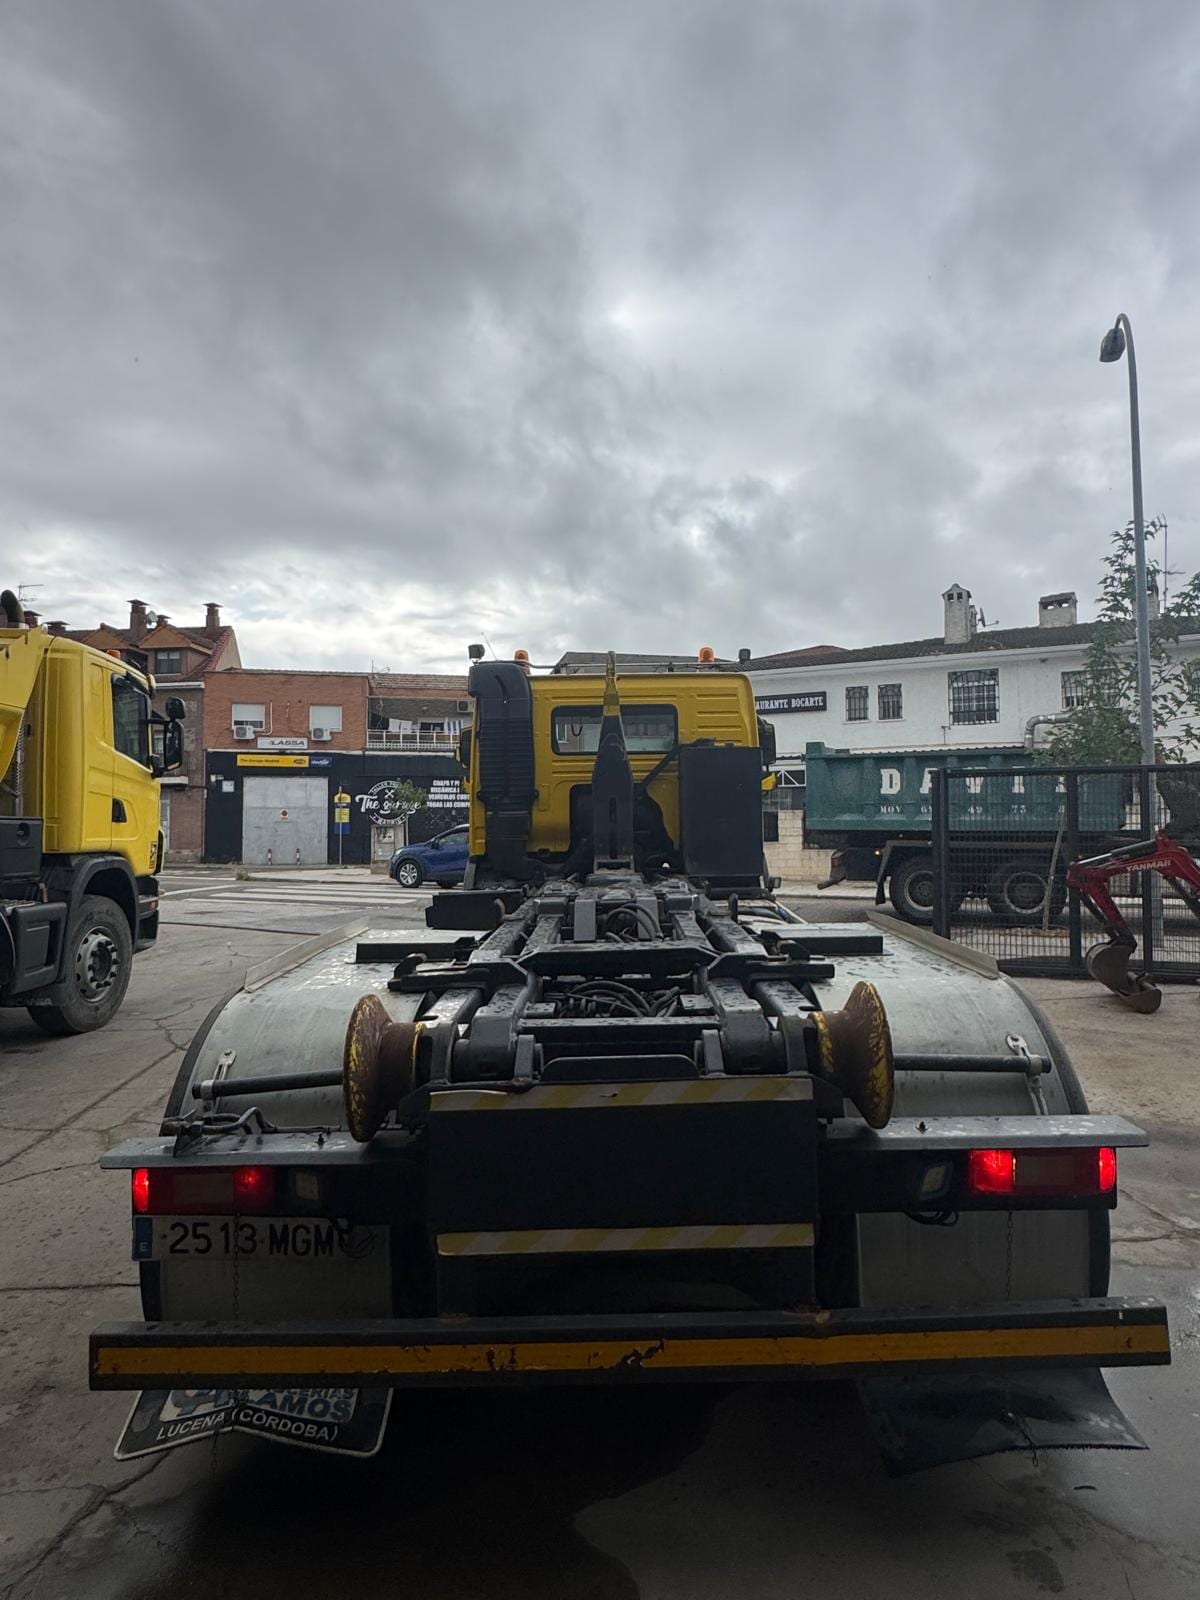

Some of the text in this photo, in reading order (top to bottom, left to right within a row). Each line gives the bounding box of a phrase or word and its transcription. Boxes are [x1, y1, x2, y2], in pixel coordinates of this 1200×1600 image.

[792, 696, 824, 708] BOCARTE
[355, 795, 380, 812] The
[1126, 860, 1172, 872] YANMAR
[168, 1222, 334, 1256] 2513 MGM
[140, 1242, 148, 1251] E
[156, 1409, 338, 1441] LUCENA (CÓRDOBA)
